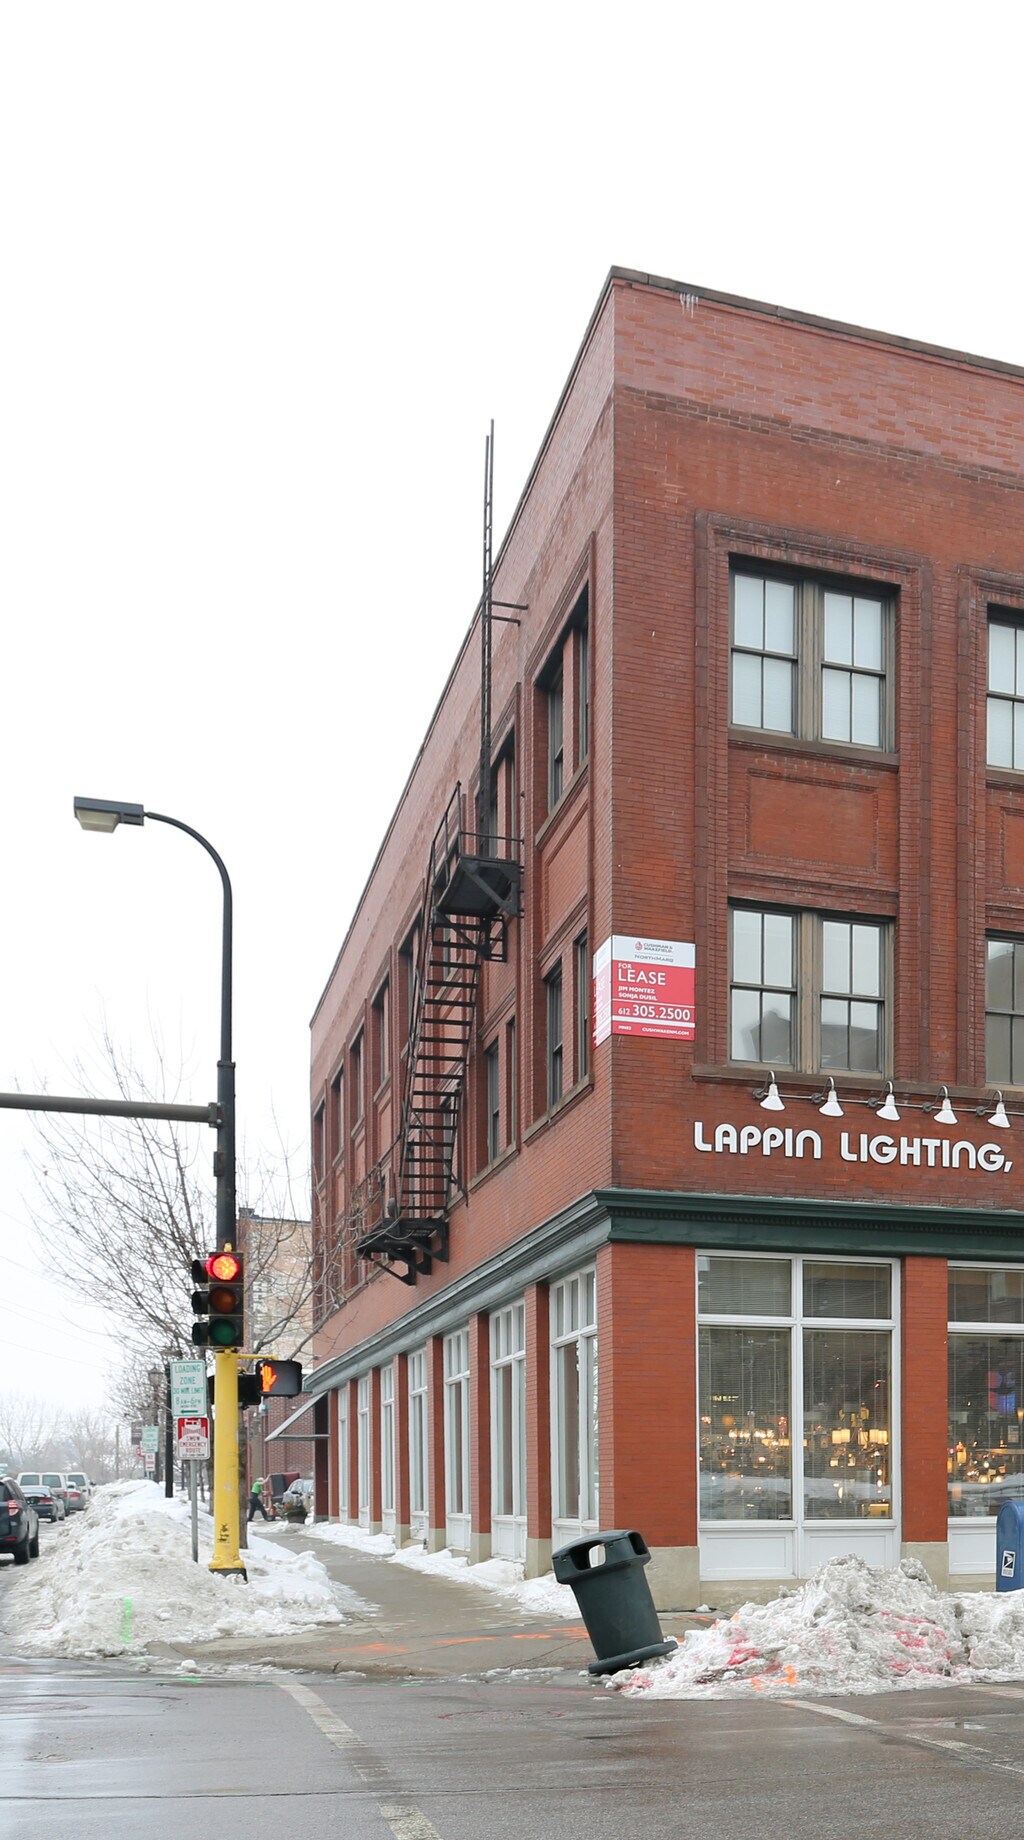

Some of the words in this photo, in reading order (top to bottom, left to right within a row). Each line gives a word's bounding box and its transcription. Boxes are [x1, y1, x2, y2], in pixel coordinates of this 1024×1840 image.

[618, 969, 666, 985] LEASE
[633, 1005, 690, 1020] 305.2500
[694, 1121, 822, 1160] LAPPIN
[174, 1364, 200, 1373] LOADING
[180, 1376, 196, 1385] ZONE
